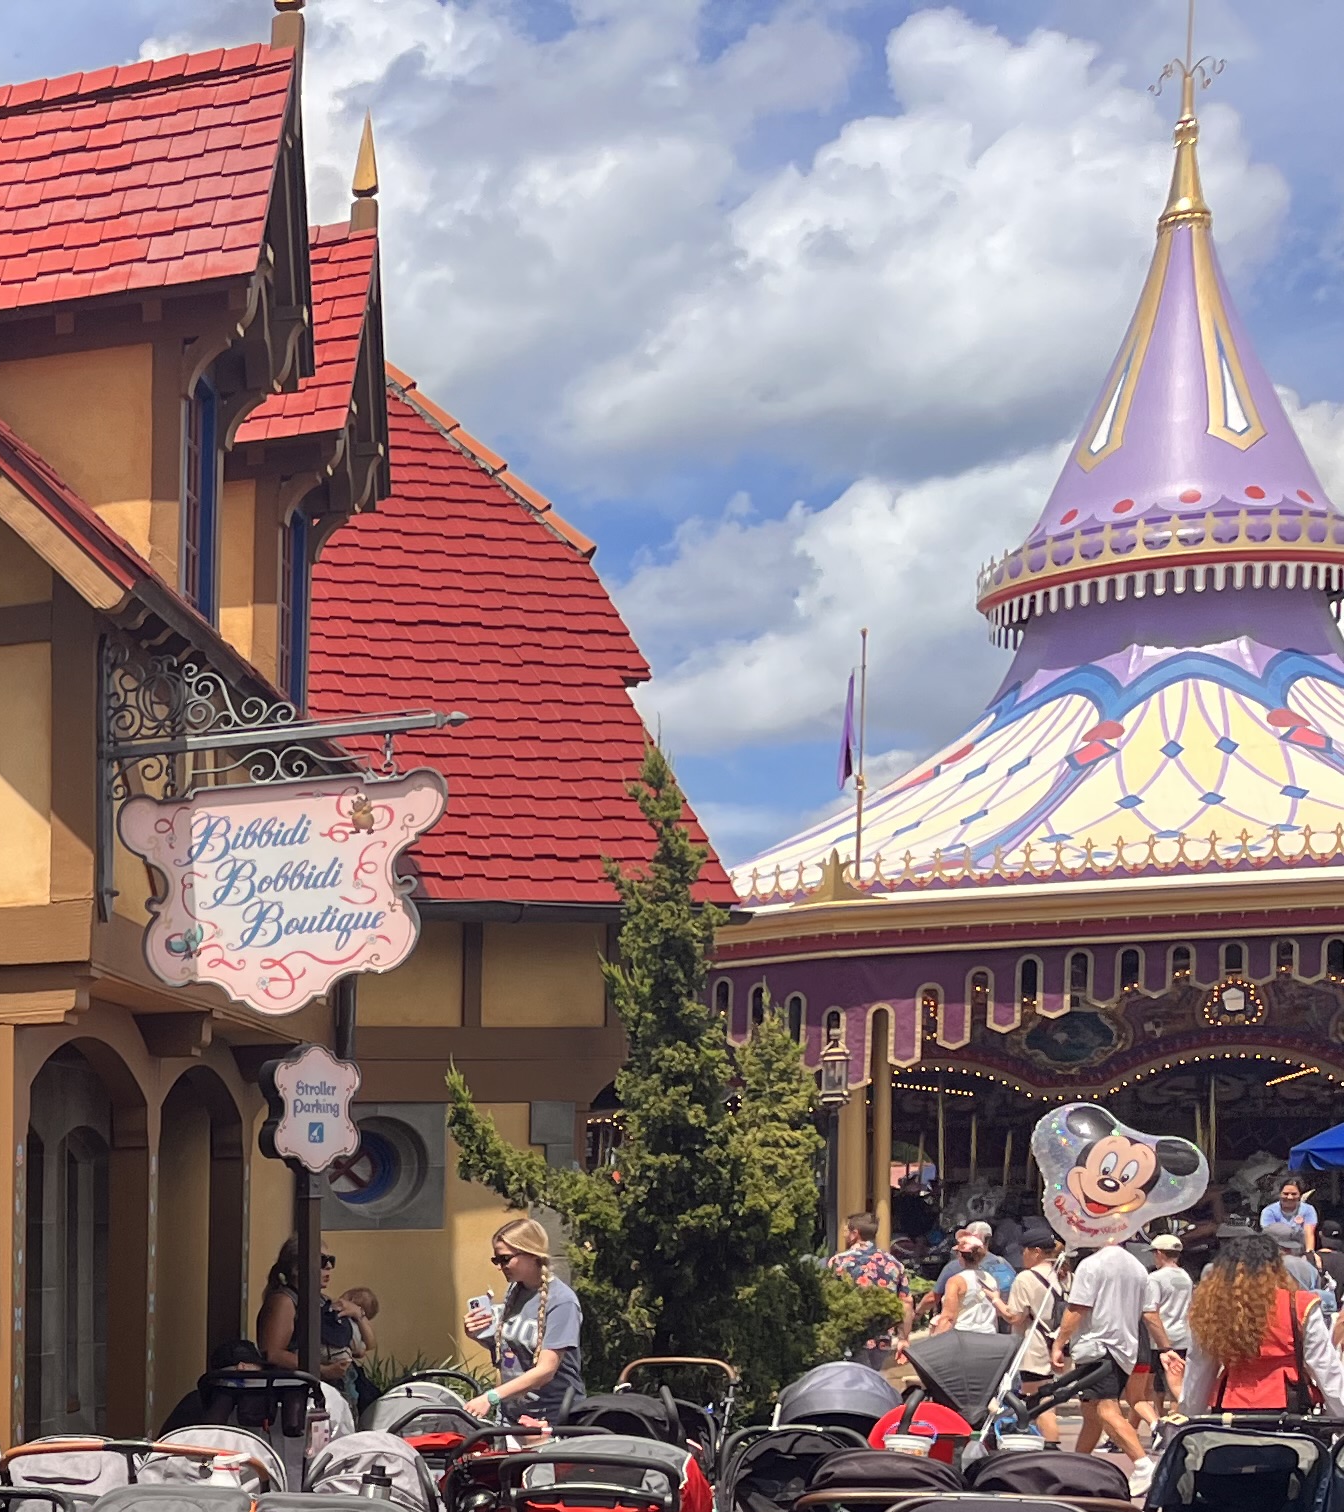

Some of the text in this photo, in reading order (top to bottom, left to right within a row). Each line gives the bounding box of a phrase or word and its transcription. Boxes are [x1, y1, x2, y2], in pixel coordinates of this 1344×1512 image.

[175, 813, 312, 866] Bibbidi
[199, 856, 343, 909] Bobbidi
[227, 901, 386, 951] Boutique
[293, 1097, 340, 1118] Parking
[296, 1080, 337, 1097] Stroller
